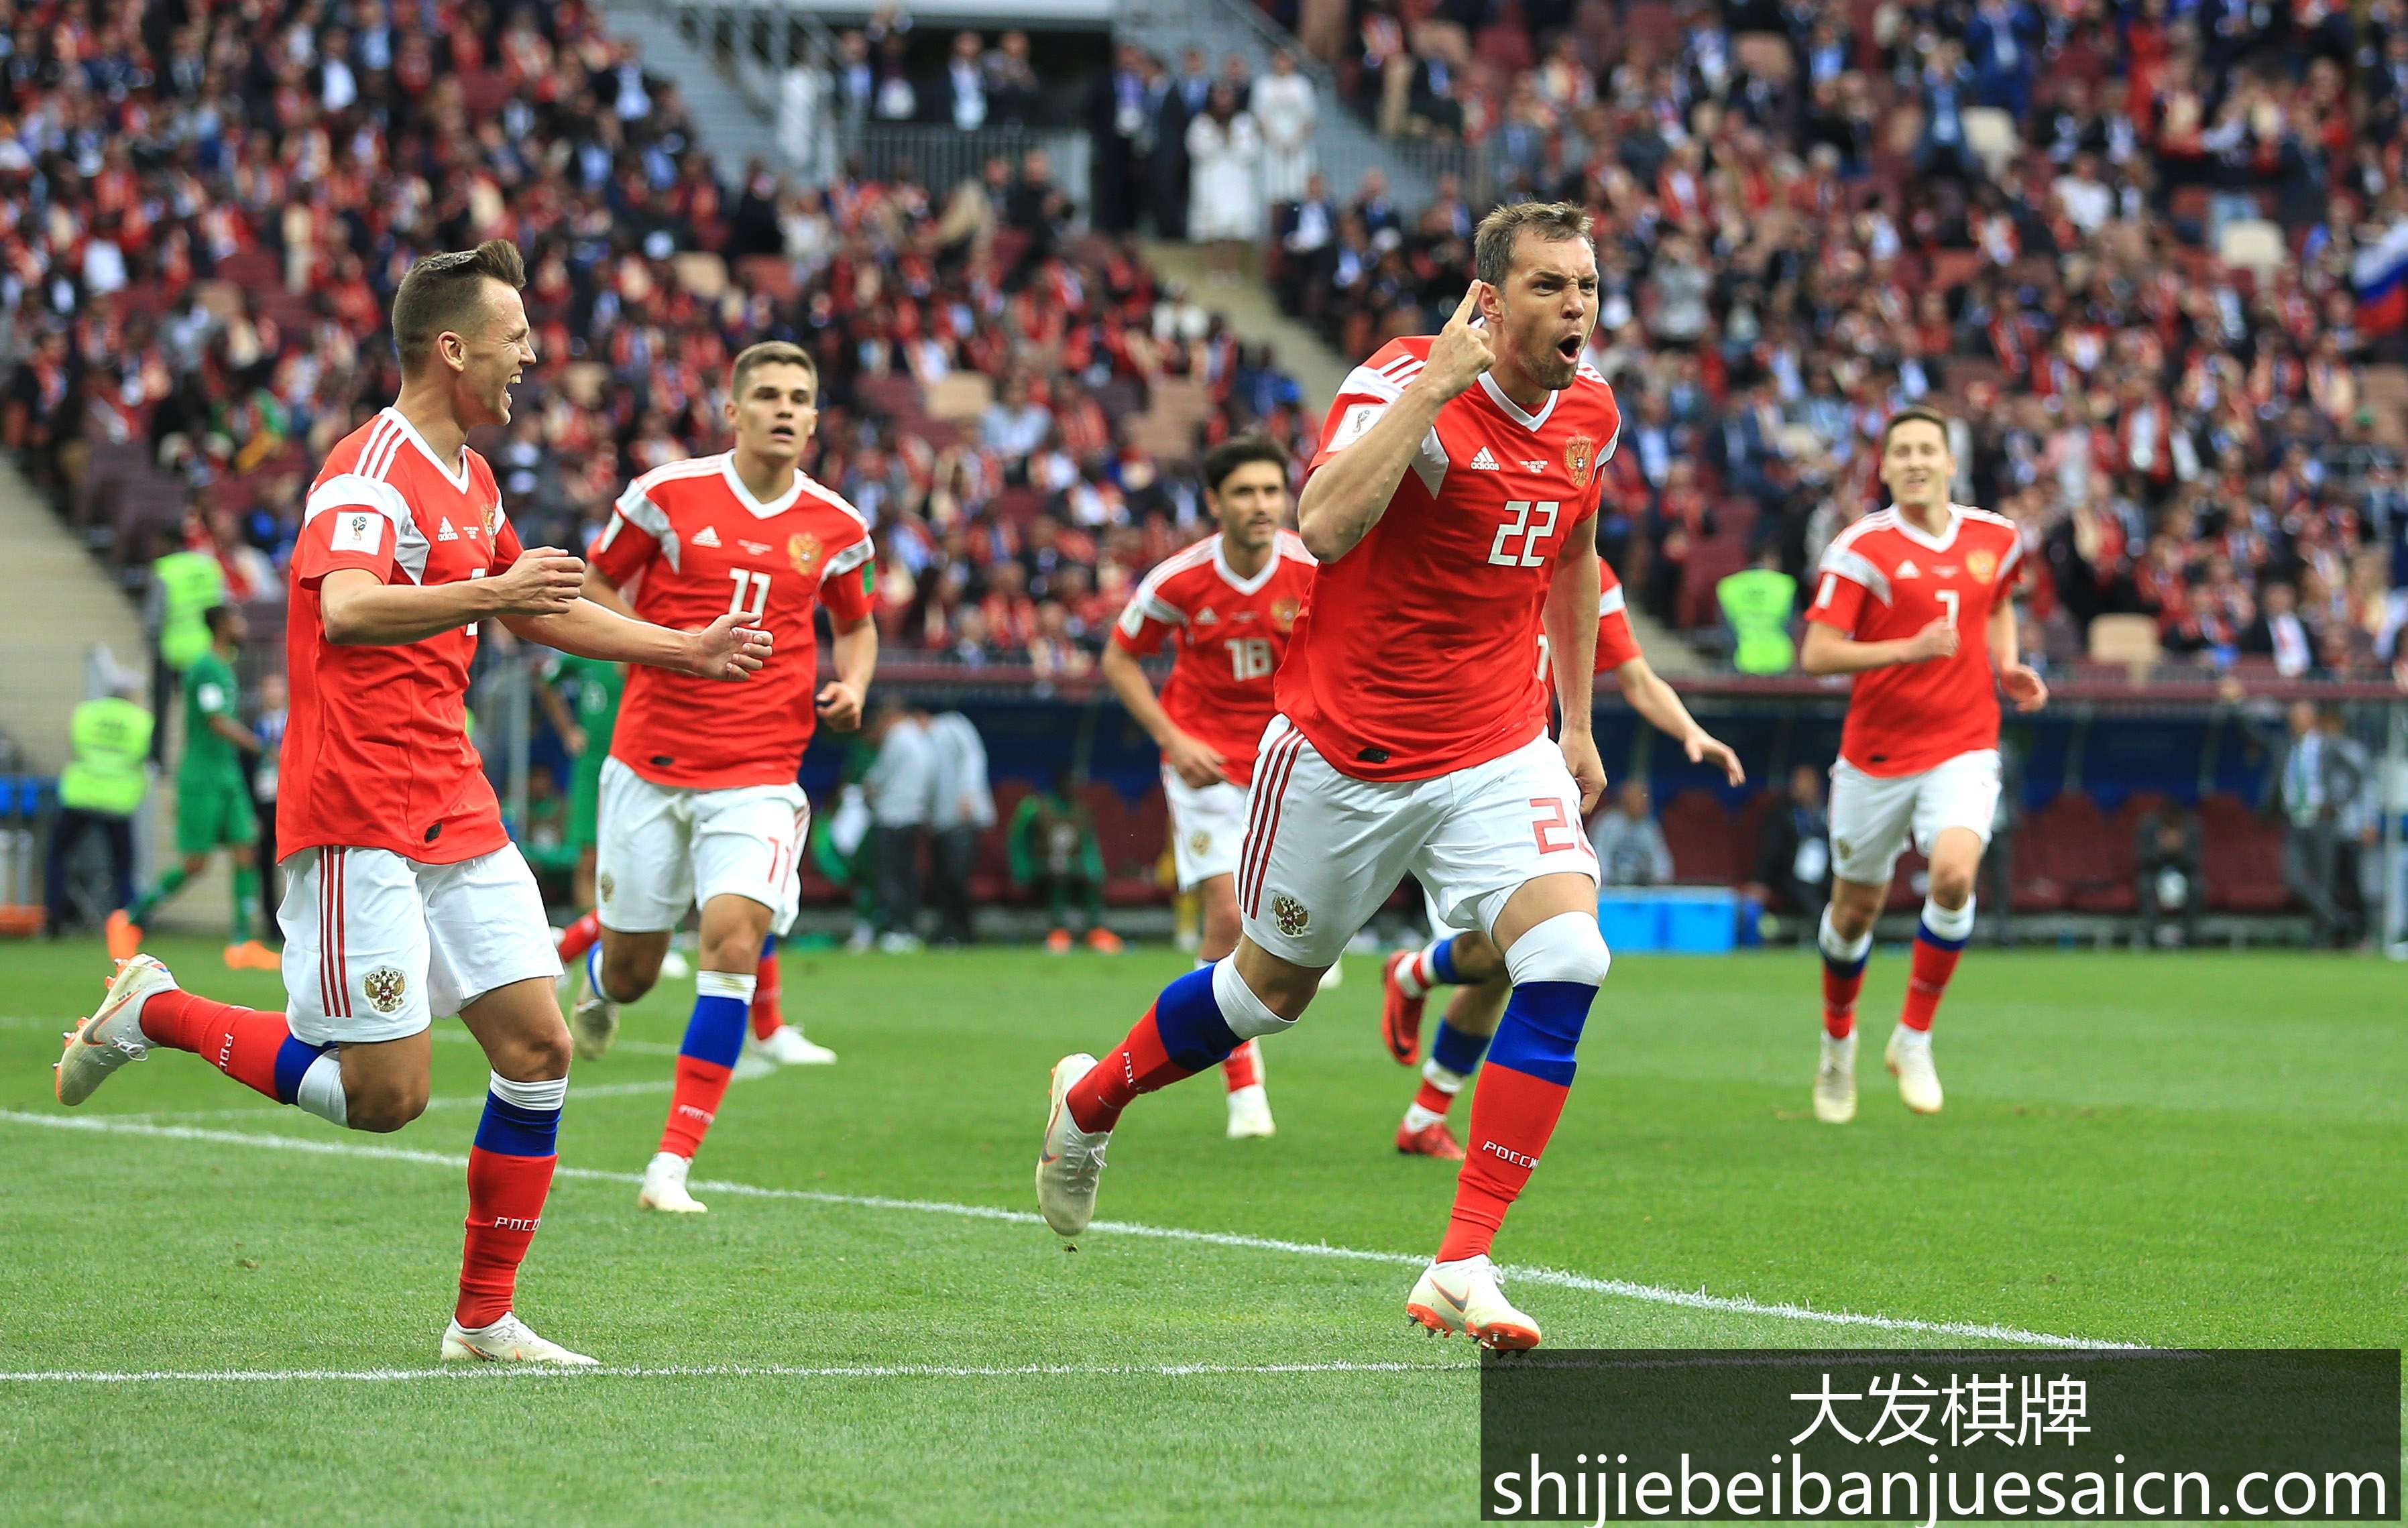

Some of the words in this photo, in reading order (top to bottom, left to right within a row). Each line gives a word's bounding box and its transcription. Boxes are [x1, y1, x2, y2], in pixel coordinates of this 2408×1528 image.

[1470, 461, 1500, 471] adidas
[1487, 500, 1560, 567] 22
[729, 567, 771, 628] 11
